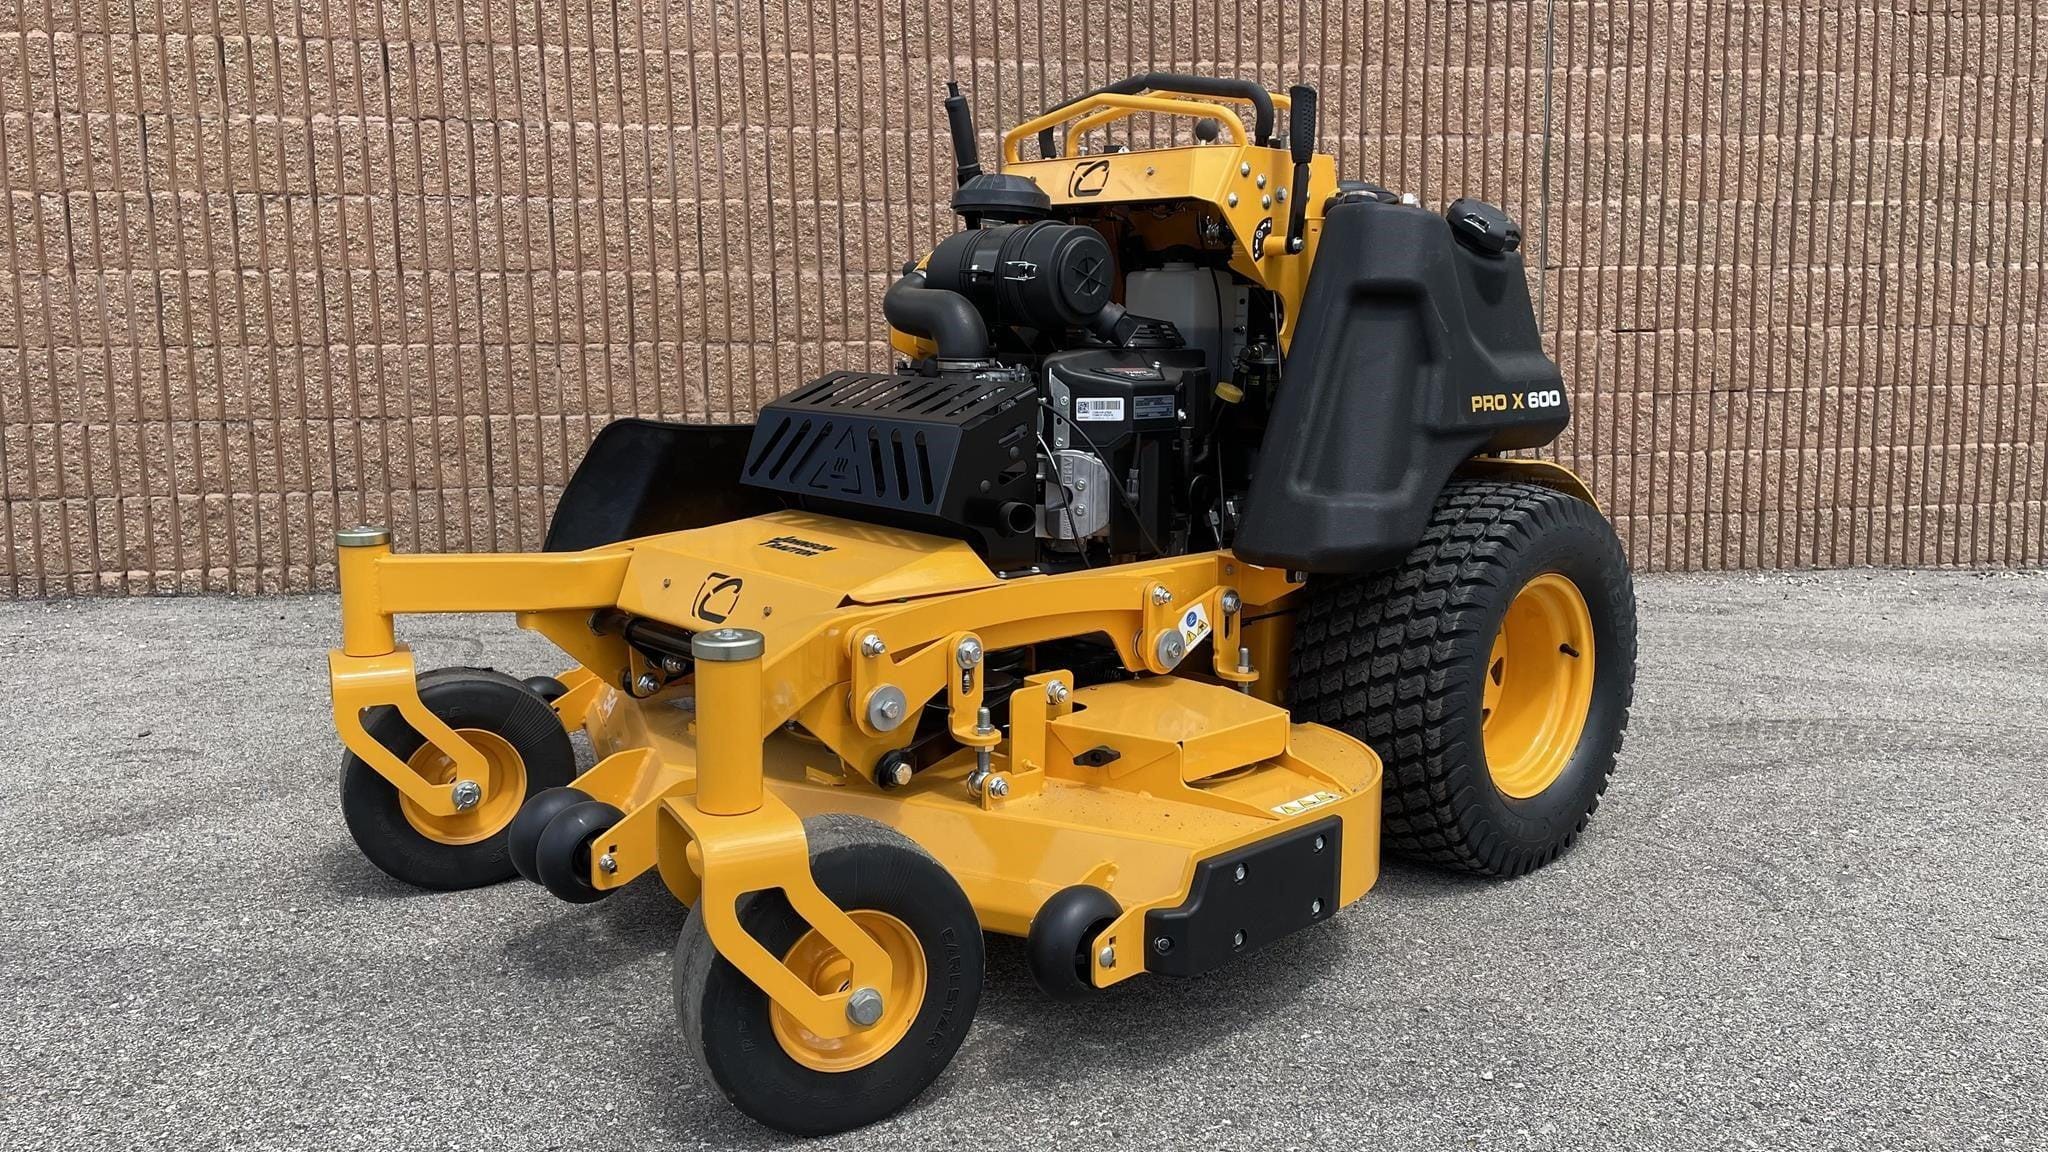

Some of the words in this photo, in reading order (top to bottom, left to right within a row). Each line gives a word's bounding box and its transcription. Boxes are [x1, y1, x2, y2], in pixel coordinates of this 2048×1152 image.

[1471, 394, 1507, 413] PRO
[1512, 393, 1525, 410] X
[1527, 390, 1561, 409] 600
[1063, 457, 1074, 484] OHV
